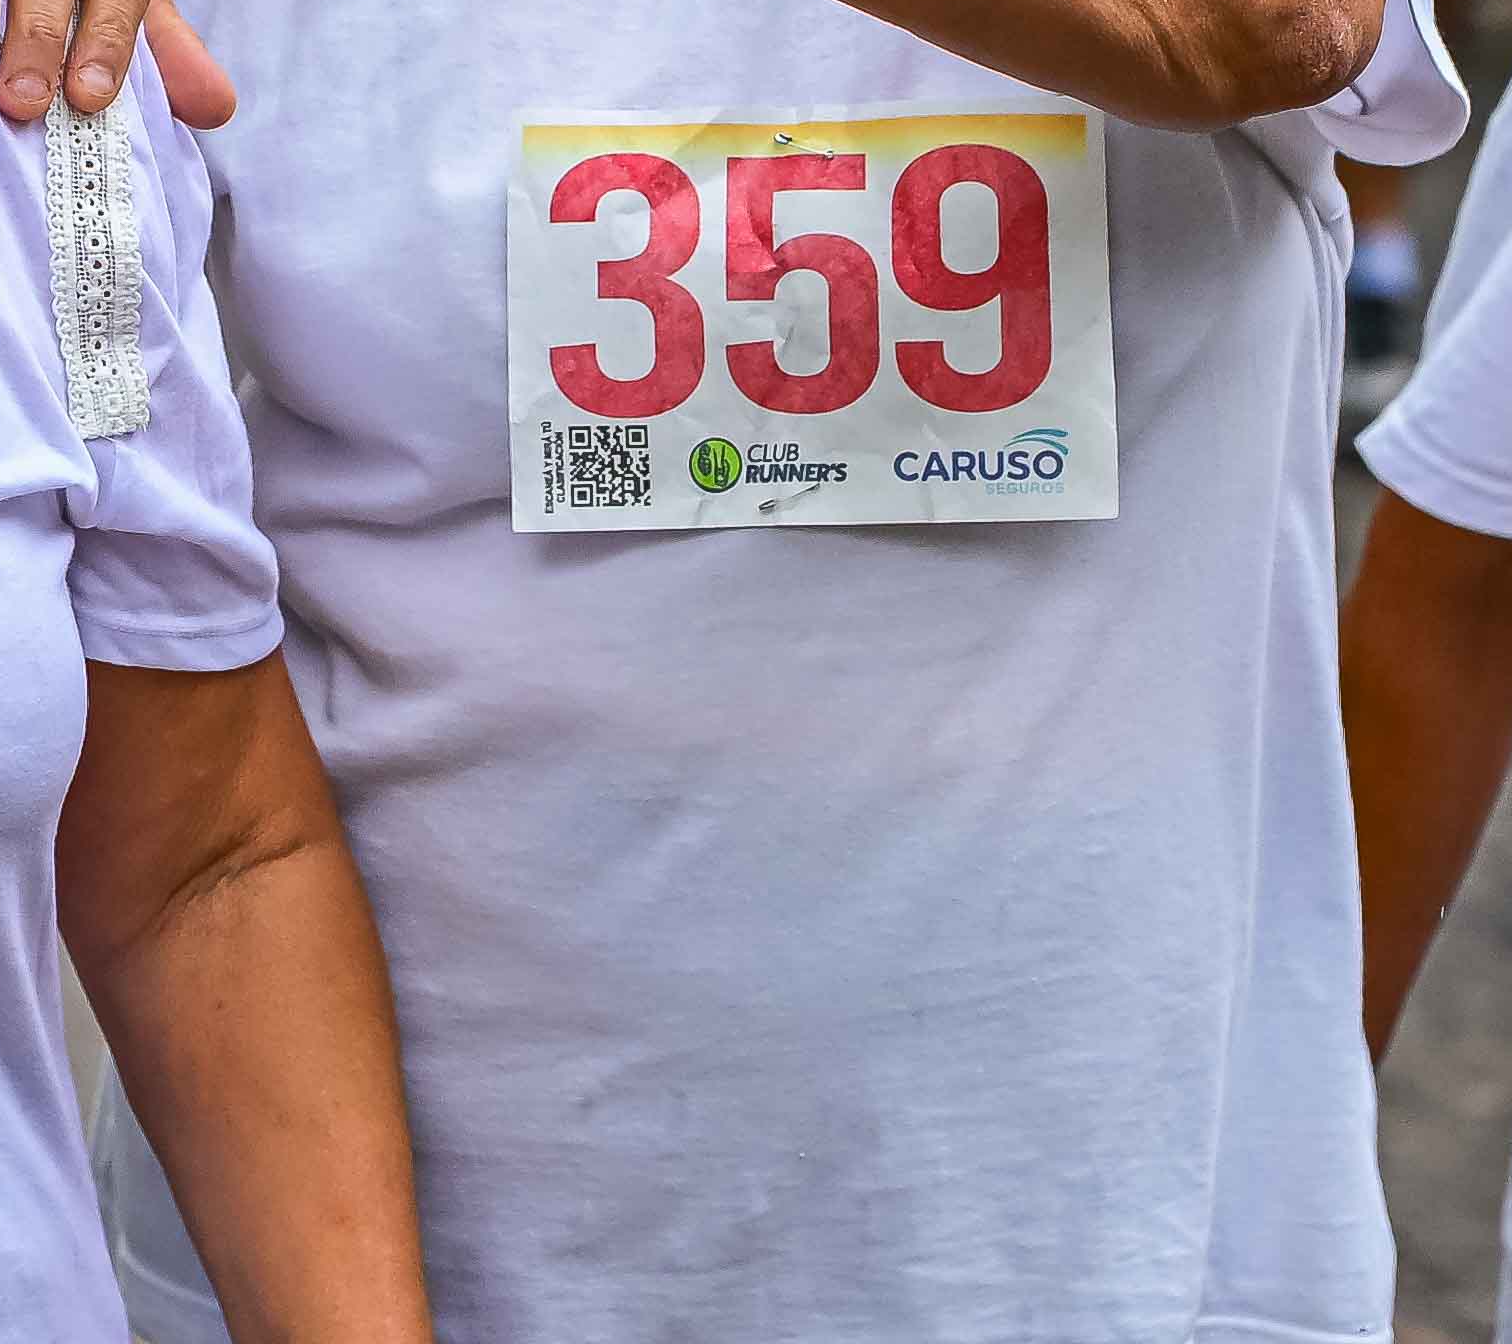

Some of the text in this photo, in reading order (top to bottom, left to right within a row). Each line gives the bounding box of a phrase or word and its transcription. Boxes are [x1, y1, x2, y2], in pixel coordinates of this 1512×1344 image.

[549, 143, 1053, 419] 359
[746, 443, 799, 462] CLUB
[745, 462, 847, 483] RUNNER'S
[893, 450, 1064, 481] CARUSO
[985, 482, 1065, 495] SEGUROS
